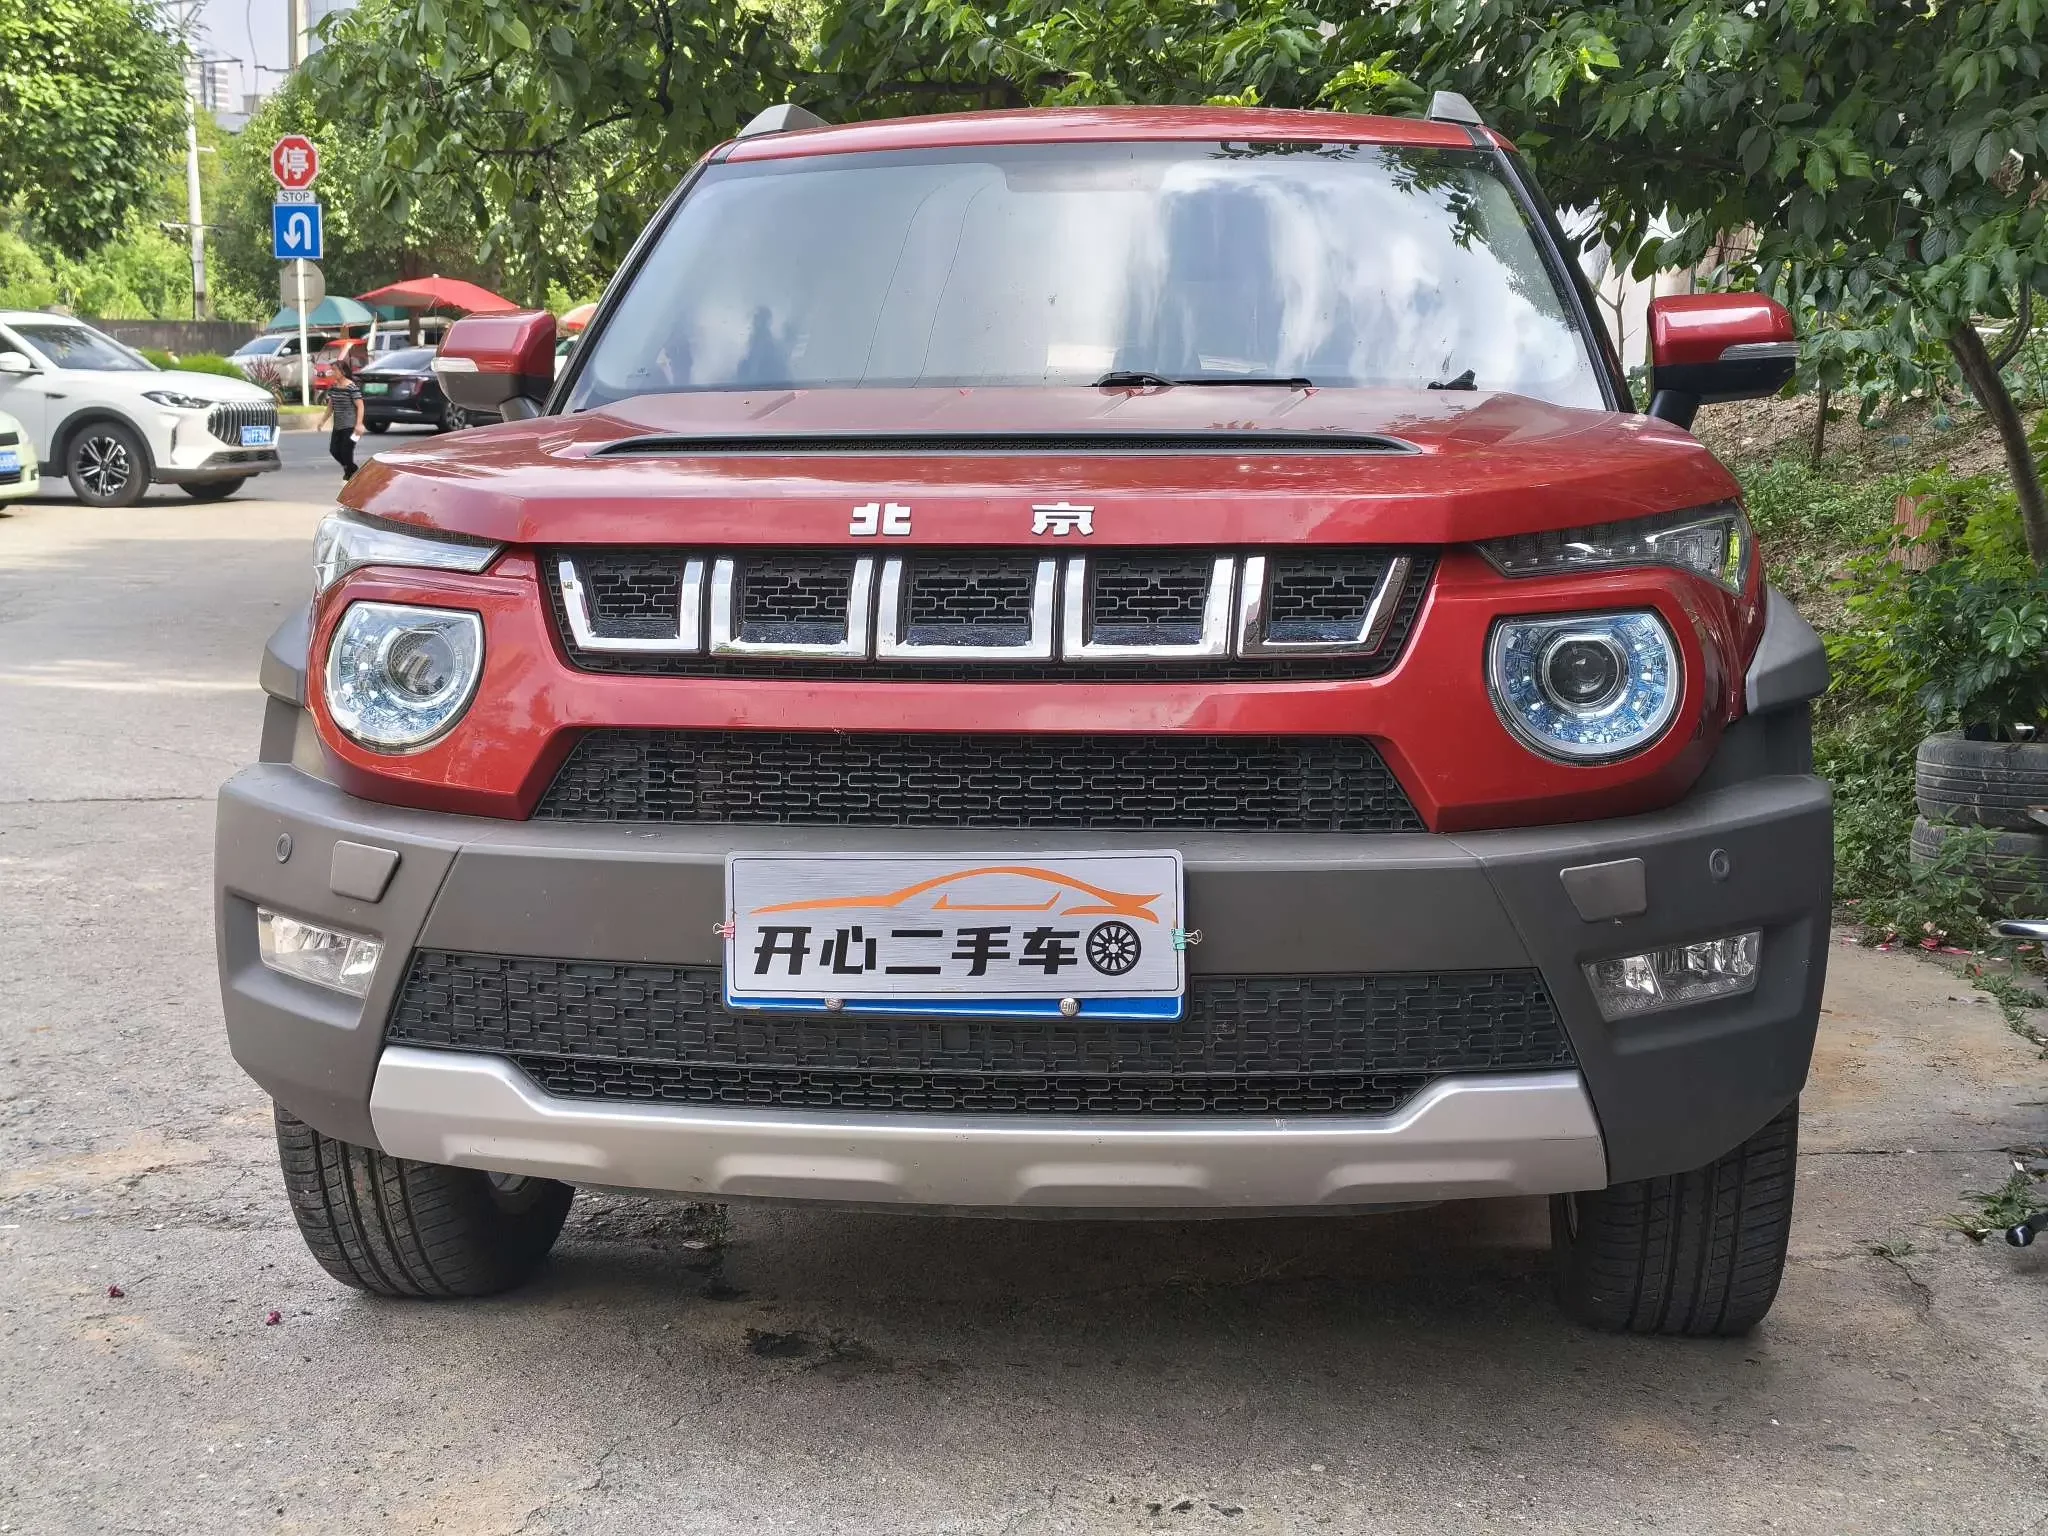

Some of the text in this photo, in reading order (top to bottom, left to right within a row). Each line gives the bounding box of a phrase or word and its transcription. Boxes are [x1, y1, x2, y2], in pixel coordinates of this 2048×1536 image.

[279, 146, 309, 180] 停
[282, 192, 310, 202] STOP
[753, 925, 1081, 977] 开心二手车
